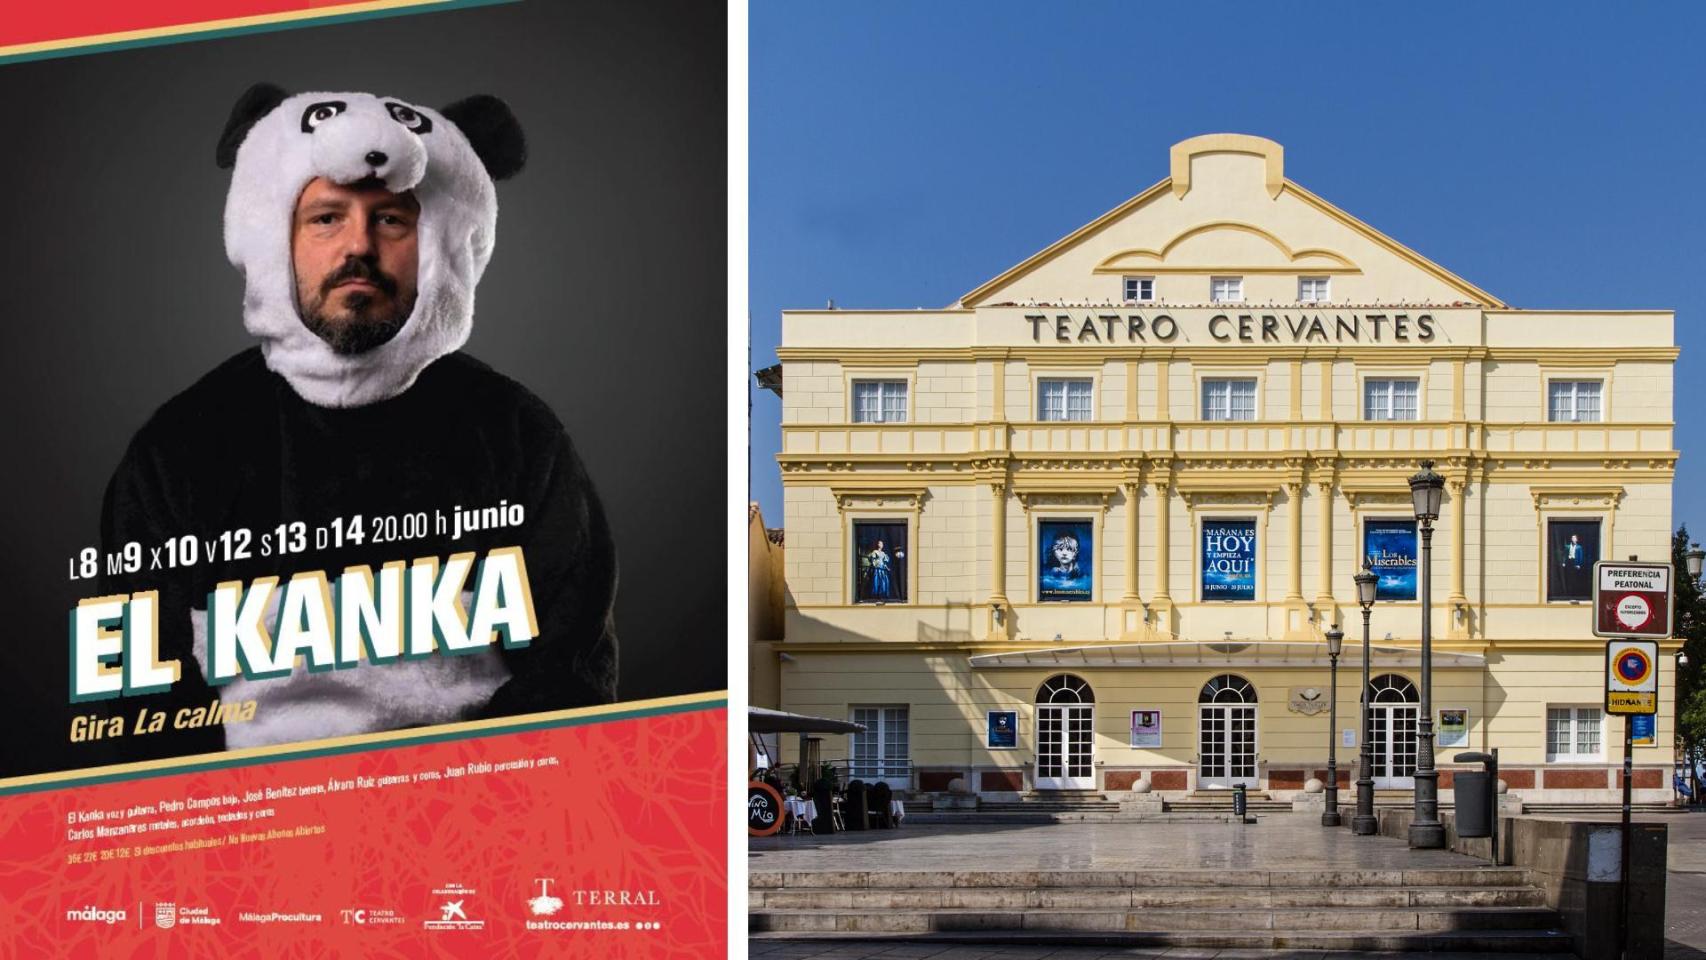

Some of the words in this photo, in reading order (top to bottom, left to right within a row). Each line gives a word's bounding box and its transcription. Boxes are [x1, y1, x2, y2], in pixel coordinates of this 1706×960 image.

[1025, 315, 1178, 340] TEATRO
[1209, 315, 1434, 340] CERVANTES
[1206, 528, 1242, 536] MAÑANA
[70, 547, 98, 580] L8
[107, 542, 142, 575] M9
[151, 535, 198, 569] X10
[206, 528, 251, 563] V12
[261, 521, 307, 557] S13
[316, 515, 365, 549] D14
[372, 512, 427, 542] 20.00
[436, 509, 446, 535] h
[452, 500, 524, 540] junio
[1206, 536, 1254, 552] HOY
[1367, 554, 1417, 566] Miserables
[1383, 549, 1398, 558] Los
[1206, 557, 1249, 573] AQUÍ
[1608, 570, 1661, 578] PREFERENCIA
[1615, 581, 1653, 589] PEATONAL
[69, 590, 180, 702] EL
[207, 545, 539, 686] KANKA
[70, 713, 124, 744] Gira
[134, 708, 168, 736] La
[173, 699, 257, 729] calma
[68, 812, 76, 824] El
[79, 810, 104, 823] Kanka
[160, 800, 185, 812] Pedro
[187, 797, 220, 809] Campos
[243, 790, 263, 802] José
[328, 777, 354, 792] Álvaro
[357, 776, 375, 788] Ruiz
[444, 766, 465, 778] Juan
[468, 762, 492, 774] Rubio
[68, 829, 94, 841] Carlos
[97, 824, 147, 837] Manzanares
[573, 891, 661, 906] TERRAL
[67, 905, 126, 924] málaga
[179, 906, 209, 916] Ciudad
[179, 917, 191, 925] de
[526, 919, 630, 930] teatrocervantes.es
